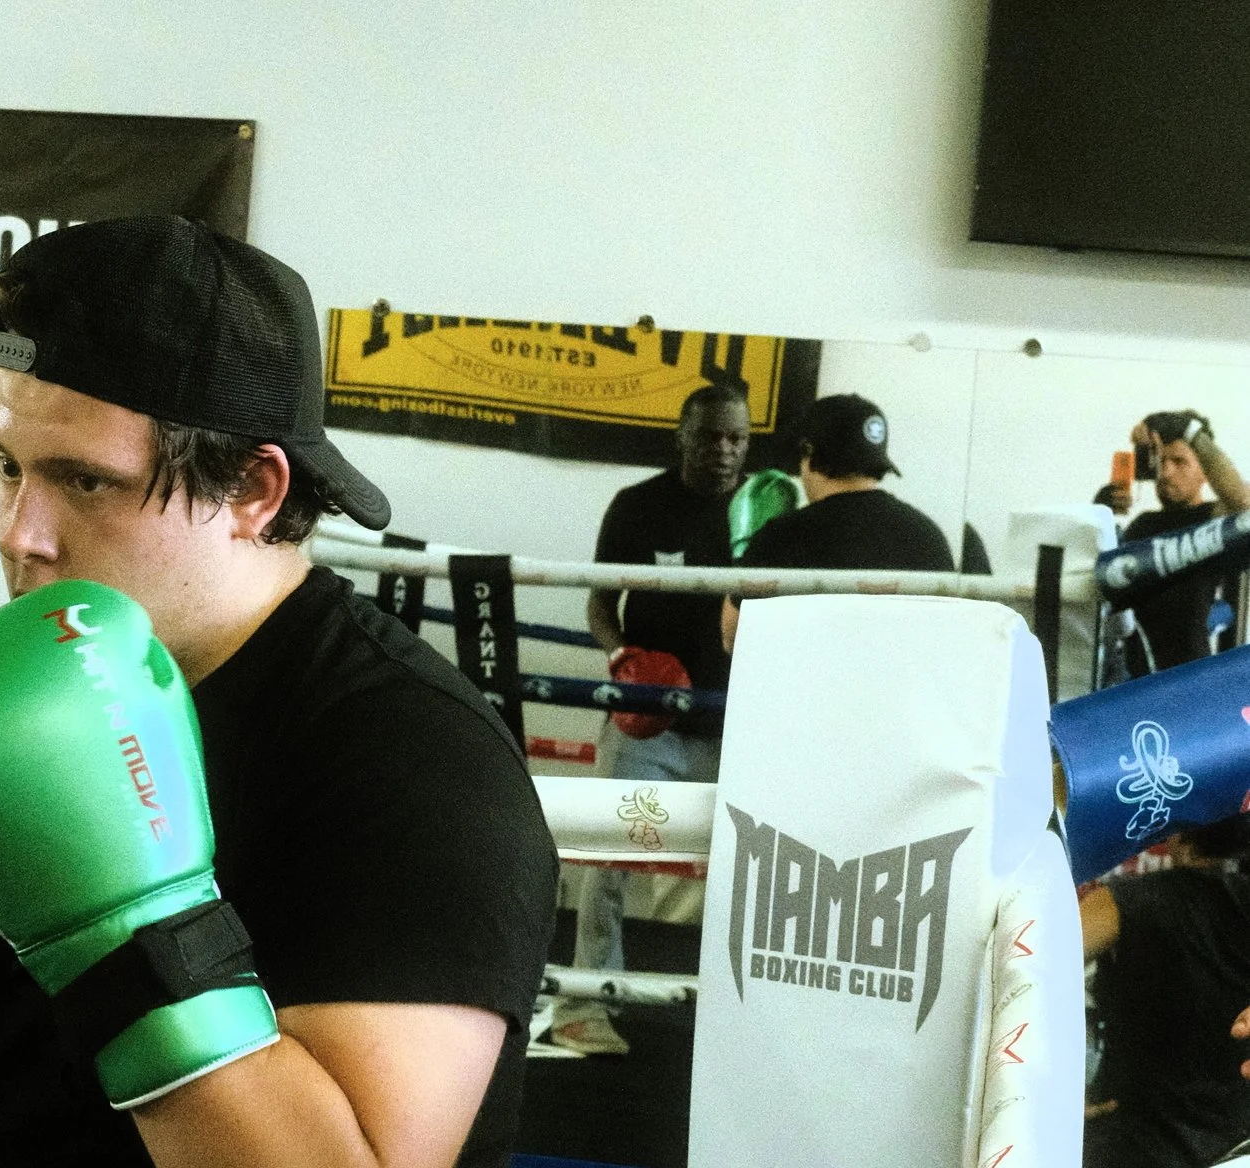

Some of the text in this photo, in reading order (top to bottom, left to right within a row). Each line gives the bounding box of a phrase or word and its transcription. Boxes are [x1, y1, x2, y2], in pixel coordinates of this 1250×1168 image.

[118, 733, 173, 842] MOVE
[725, 801, 975, 1034] MAMBA
[750, 953, 914, 1003] BOXING CLUB
